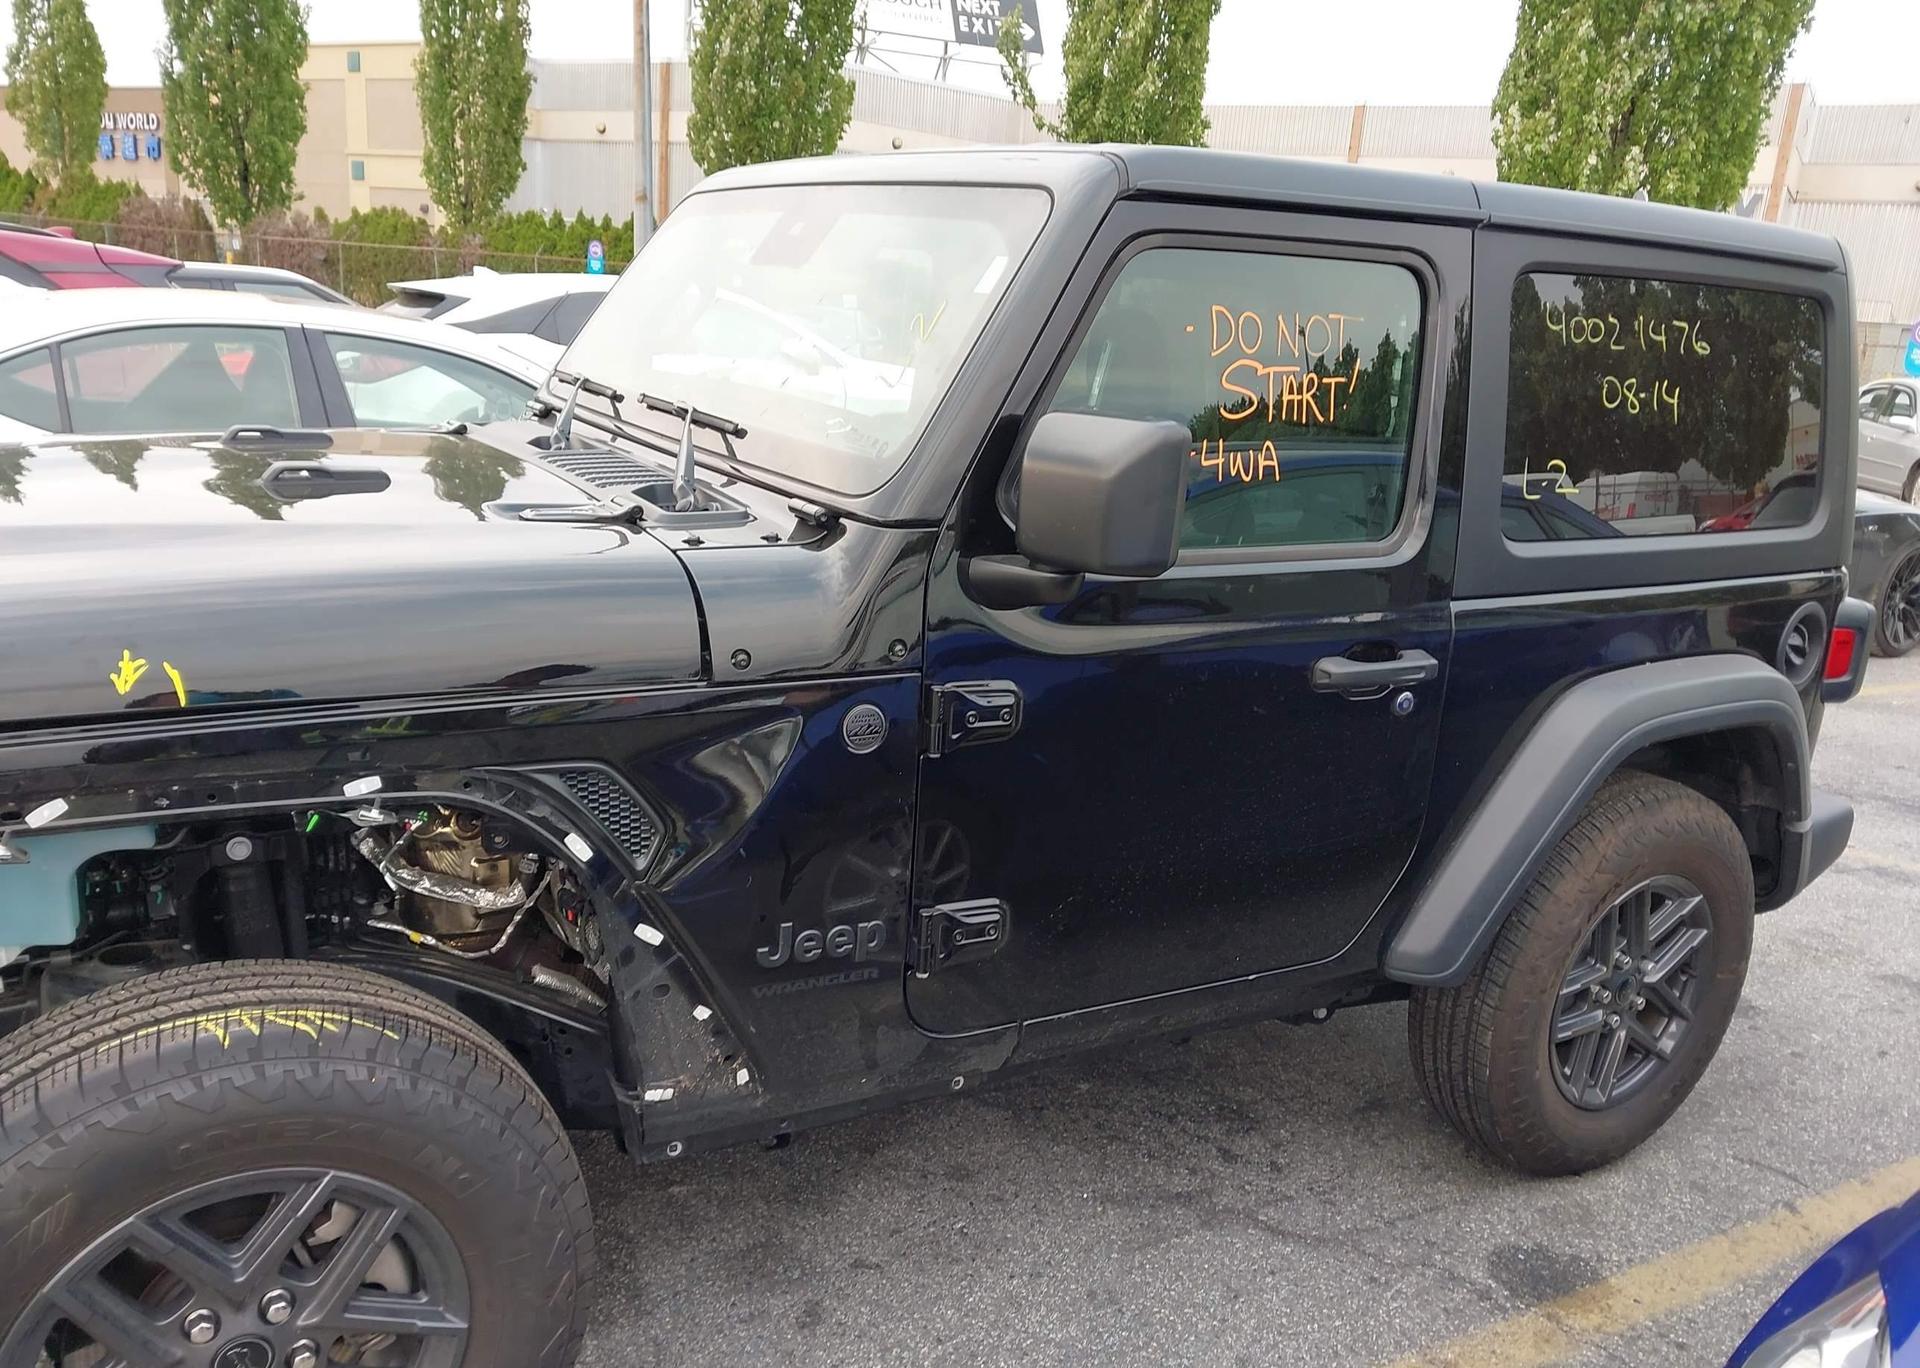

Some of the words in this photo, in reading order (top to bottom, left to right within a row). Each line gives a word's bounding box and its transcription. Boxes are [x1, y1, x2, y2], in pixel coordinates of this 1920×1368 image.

[956, 0, 1001, 16] NEXT
[116, 111, 158, 131] WORLD
[1210, 304, 1263, 357] DO
[1276, 311, 1365, 363] NOT
[1219, 357, 1361, 424] START!
[756, 919, 888, 969] Jeep
[752, 967, 880, 999] WRANGLER
